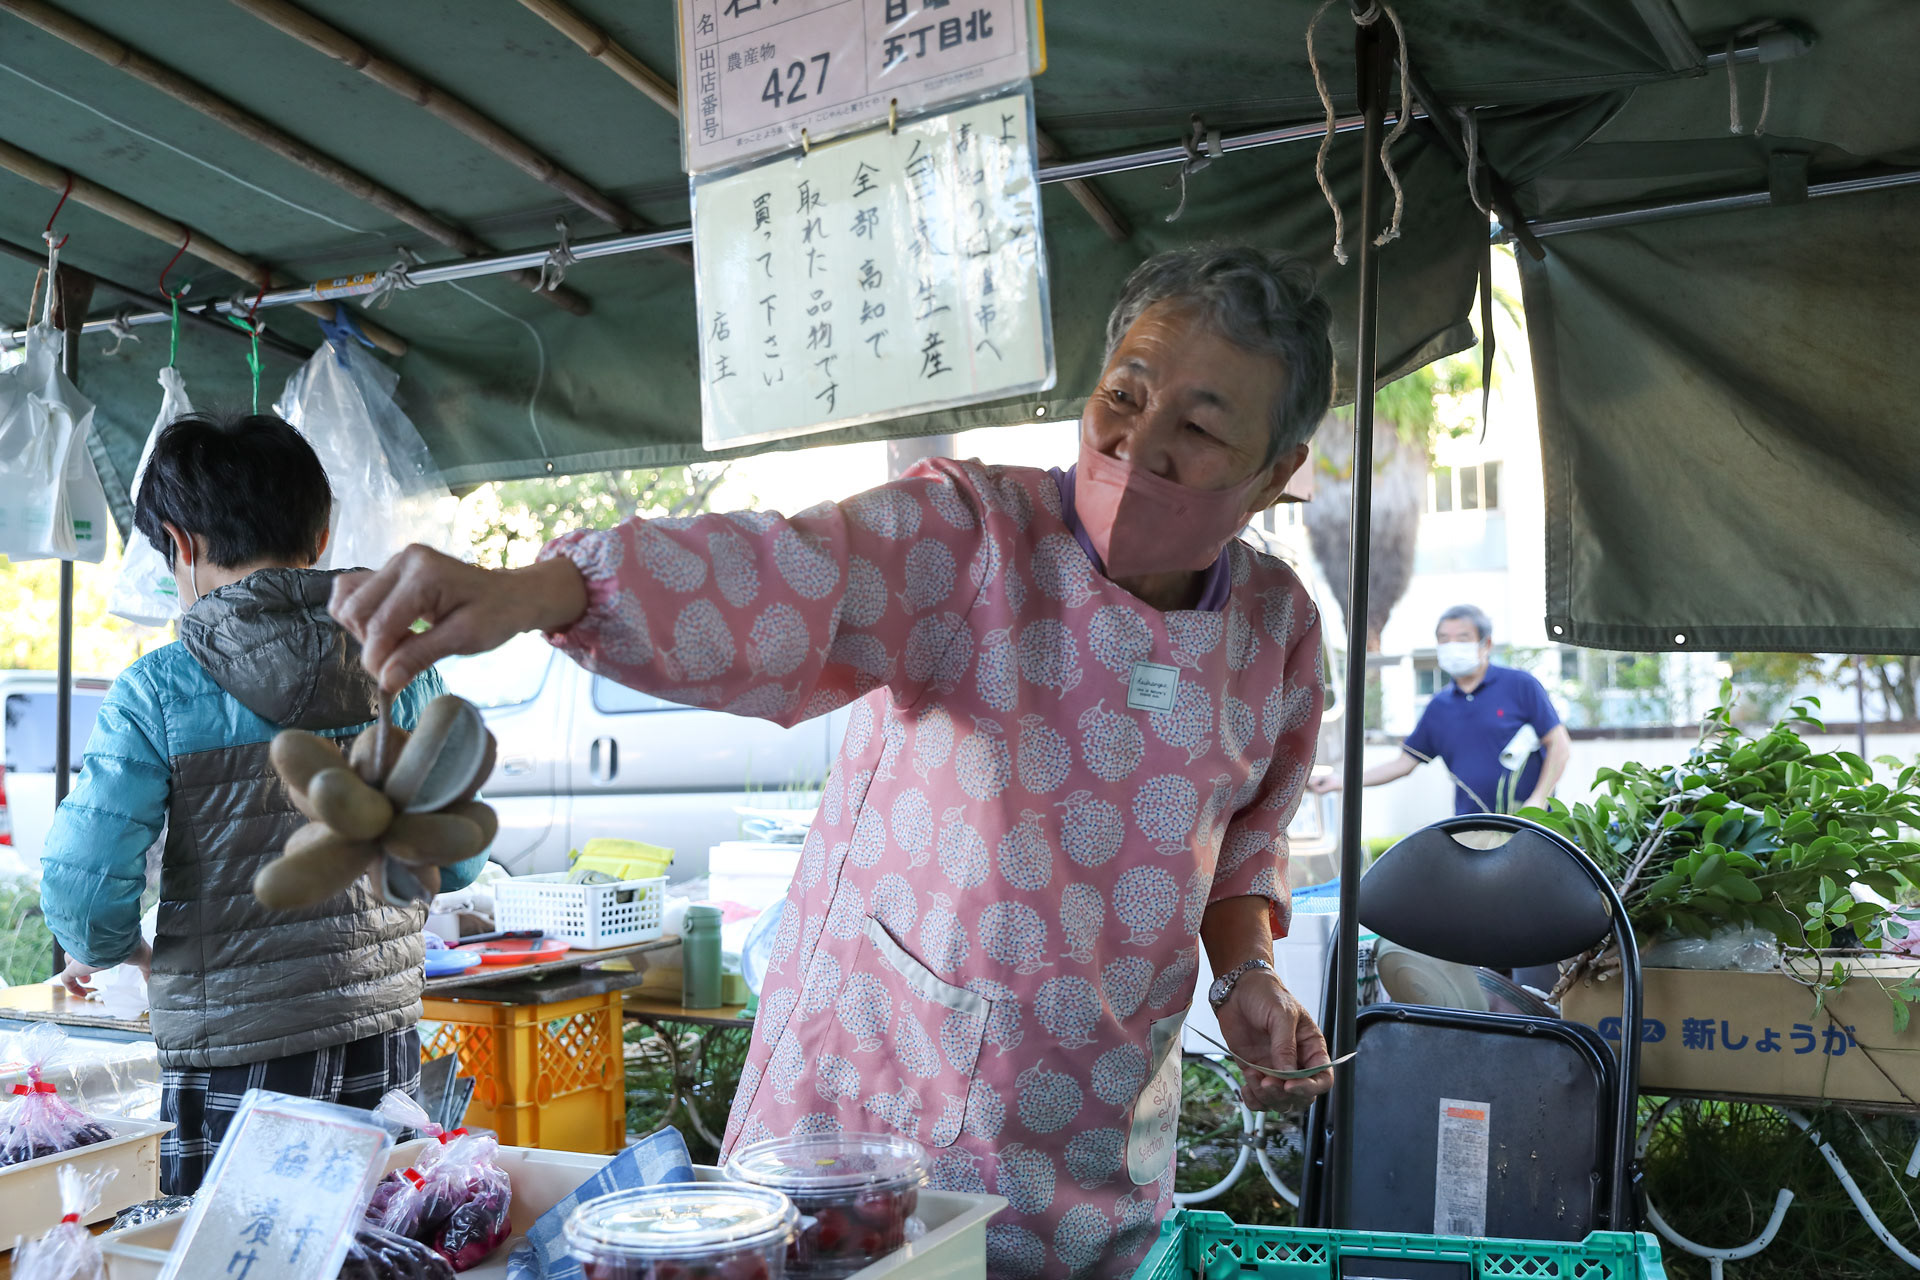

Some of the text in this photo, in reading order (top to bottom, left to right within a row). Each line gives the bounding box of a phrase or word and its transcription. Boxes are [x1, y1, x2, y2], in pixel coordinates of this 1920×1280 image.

[727, 42, 776, 73] 農産物
[882, 8, 993, 69] 五丁目北
[699, 49, 719, 138] 出店番号
[761, 52, 830, 108] 427
[752, 192, 784, 386] 買って下さい
[850, 161, 889, 358] 全部高知で
[797, 179, 839, 415] 取れた品物です
[707, 311, 737, 384] 店主
[1603, 1017, 1857, 1056] ハス 新しょうが
